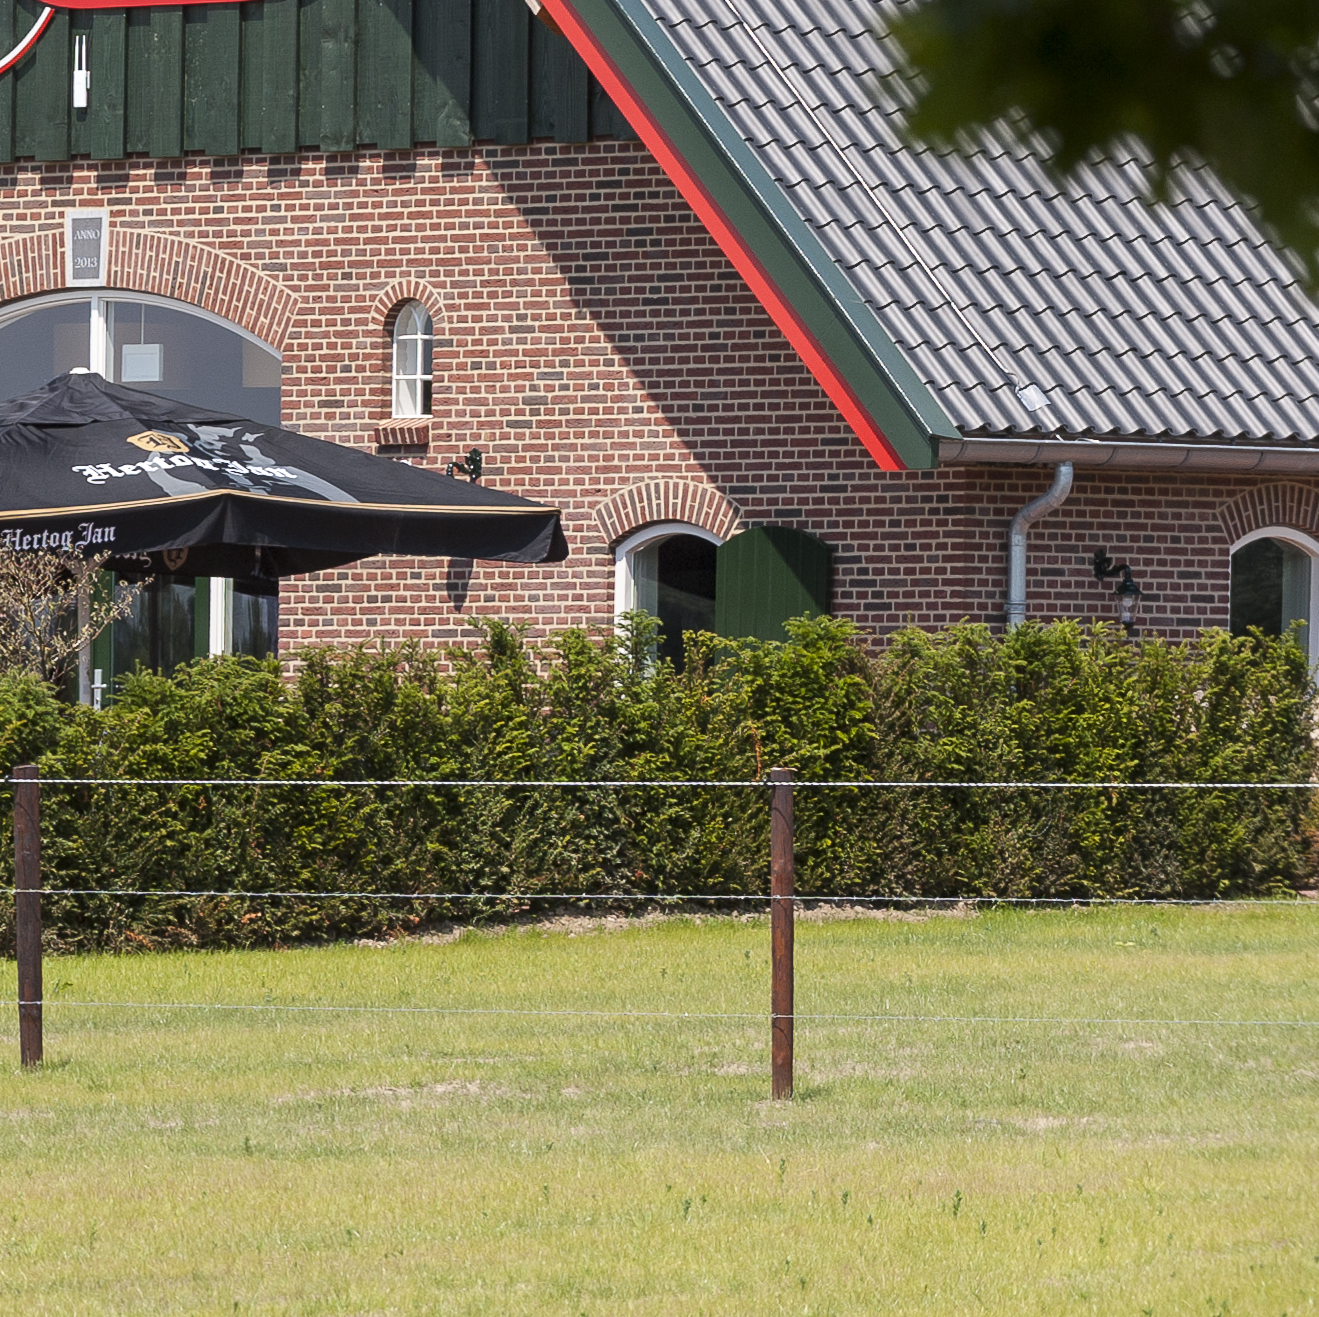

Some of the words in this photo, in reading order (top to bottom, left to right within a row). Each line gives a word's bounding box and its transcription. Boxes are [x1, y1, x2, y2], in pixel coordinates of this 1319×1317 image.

[74, 229, 100, 240] ANNO
[74, 256, 98, 268] 2013
[1, 529, 74, 552] Hertog
[75, 522, 116, 552] Jan
